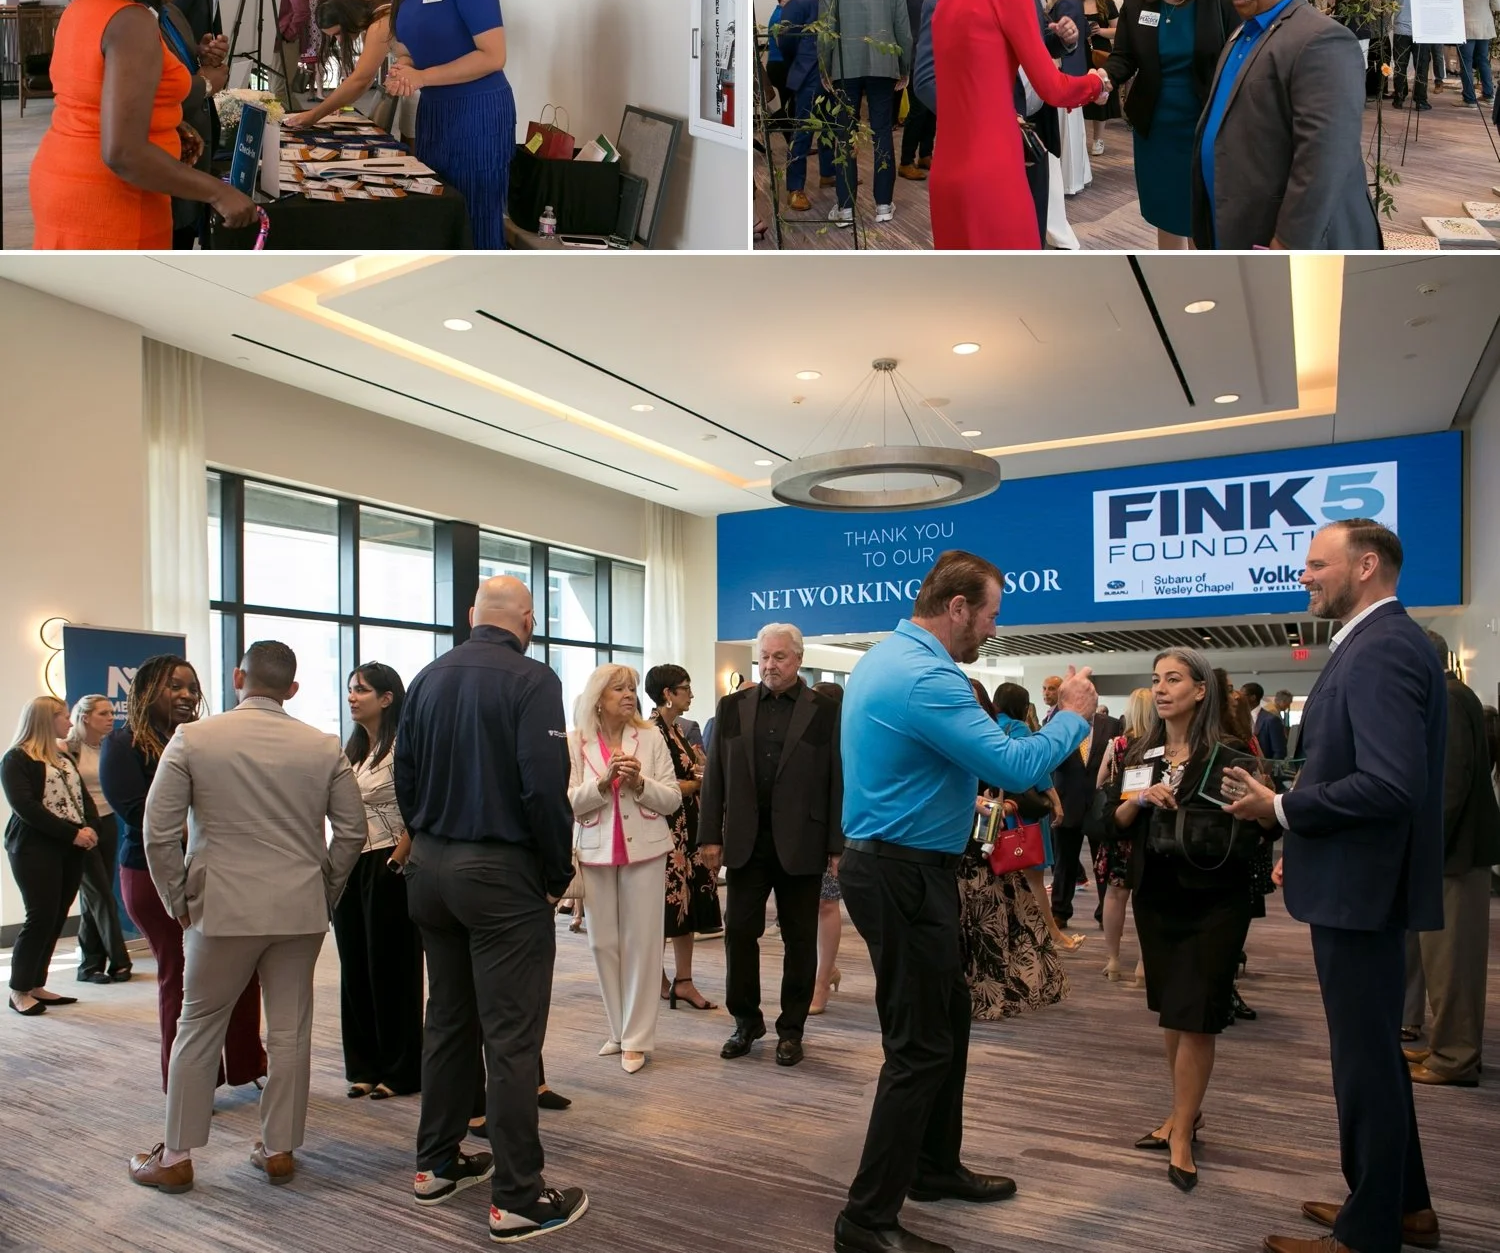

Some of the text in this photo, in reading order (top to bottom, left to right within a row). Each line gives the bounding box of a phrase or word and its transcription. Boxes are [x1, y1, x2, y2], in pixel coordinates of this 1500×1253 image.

[1108, 476, 1317, 540] FINK
[843, 521, 954, 547] THANK YOU
[1108, 530, 1314, 564] FOUNDATI
[862, 547, 934, 567] TO OUR
[1154, 573, 1207, 585] Subaru of
[1154, 582, 1234, 596] Wesley Chapel
[750, 578, 921, 611] NETWORKING
